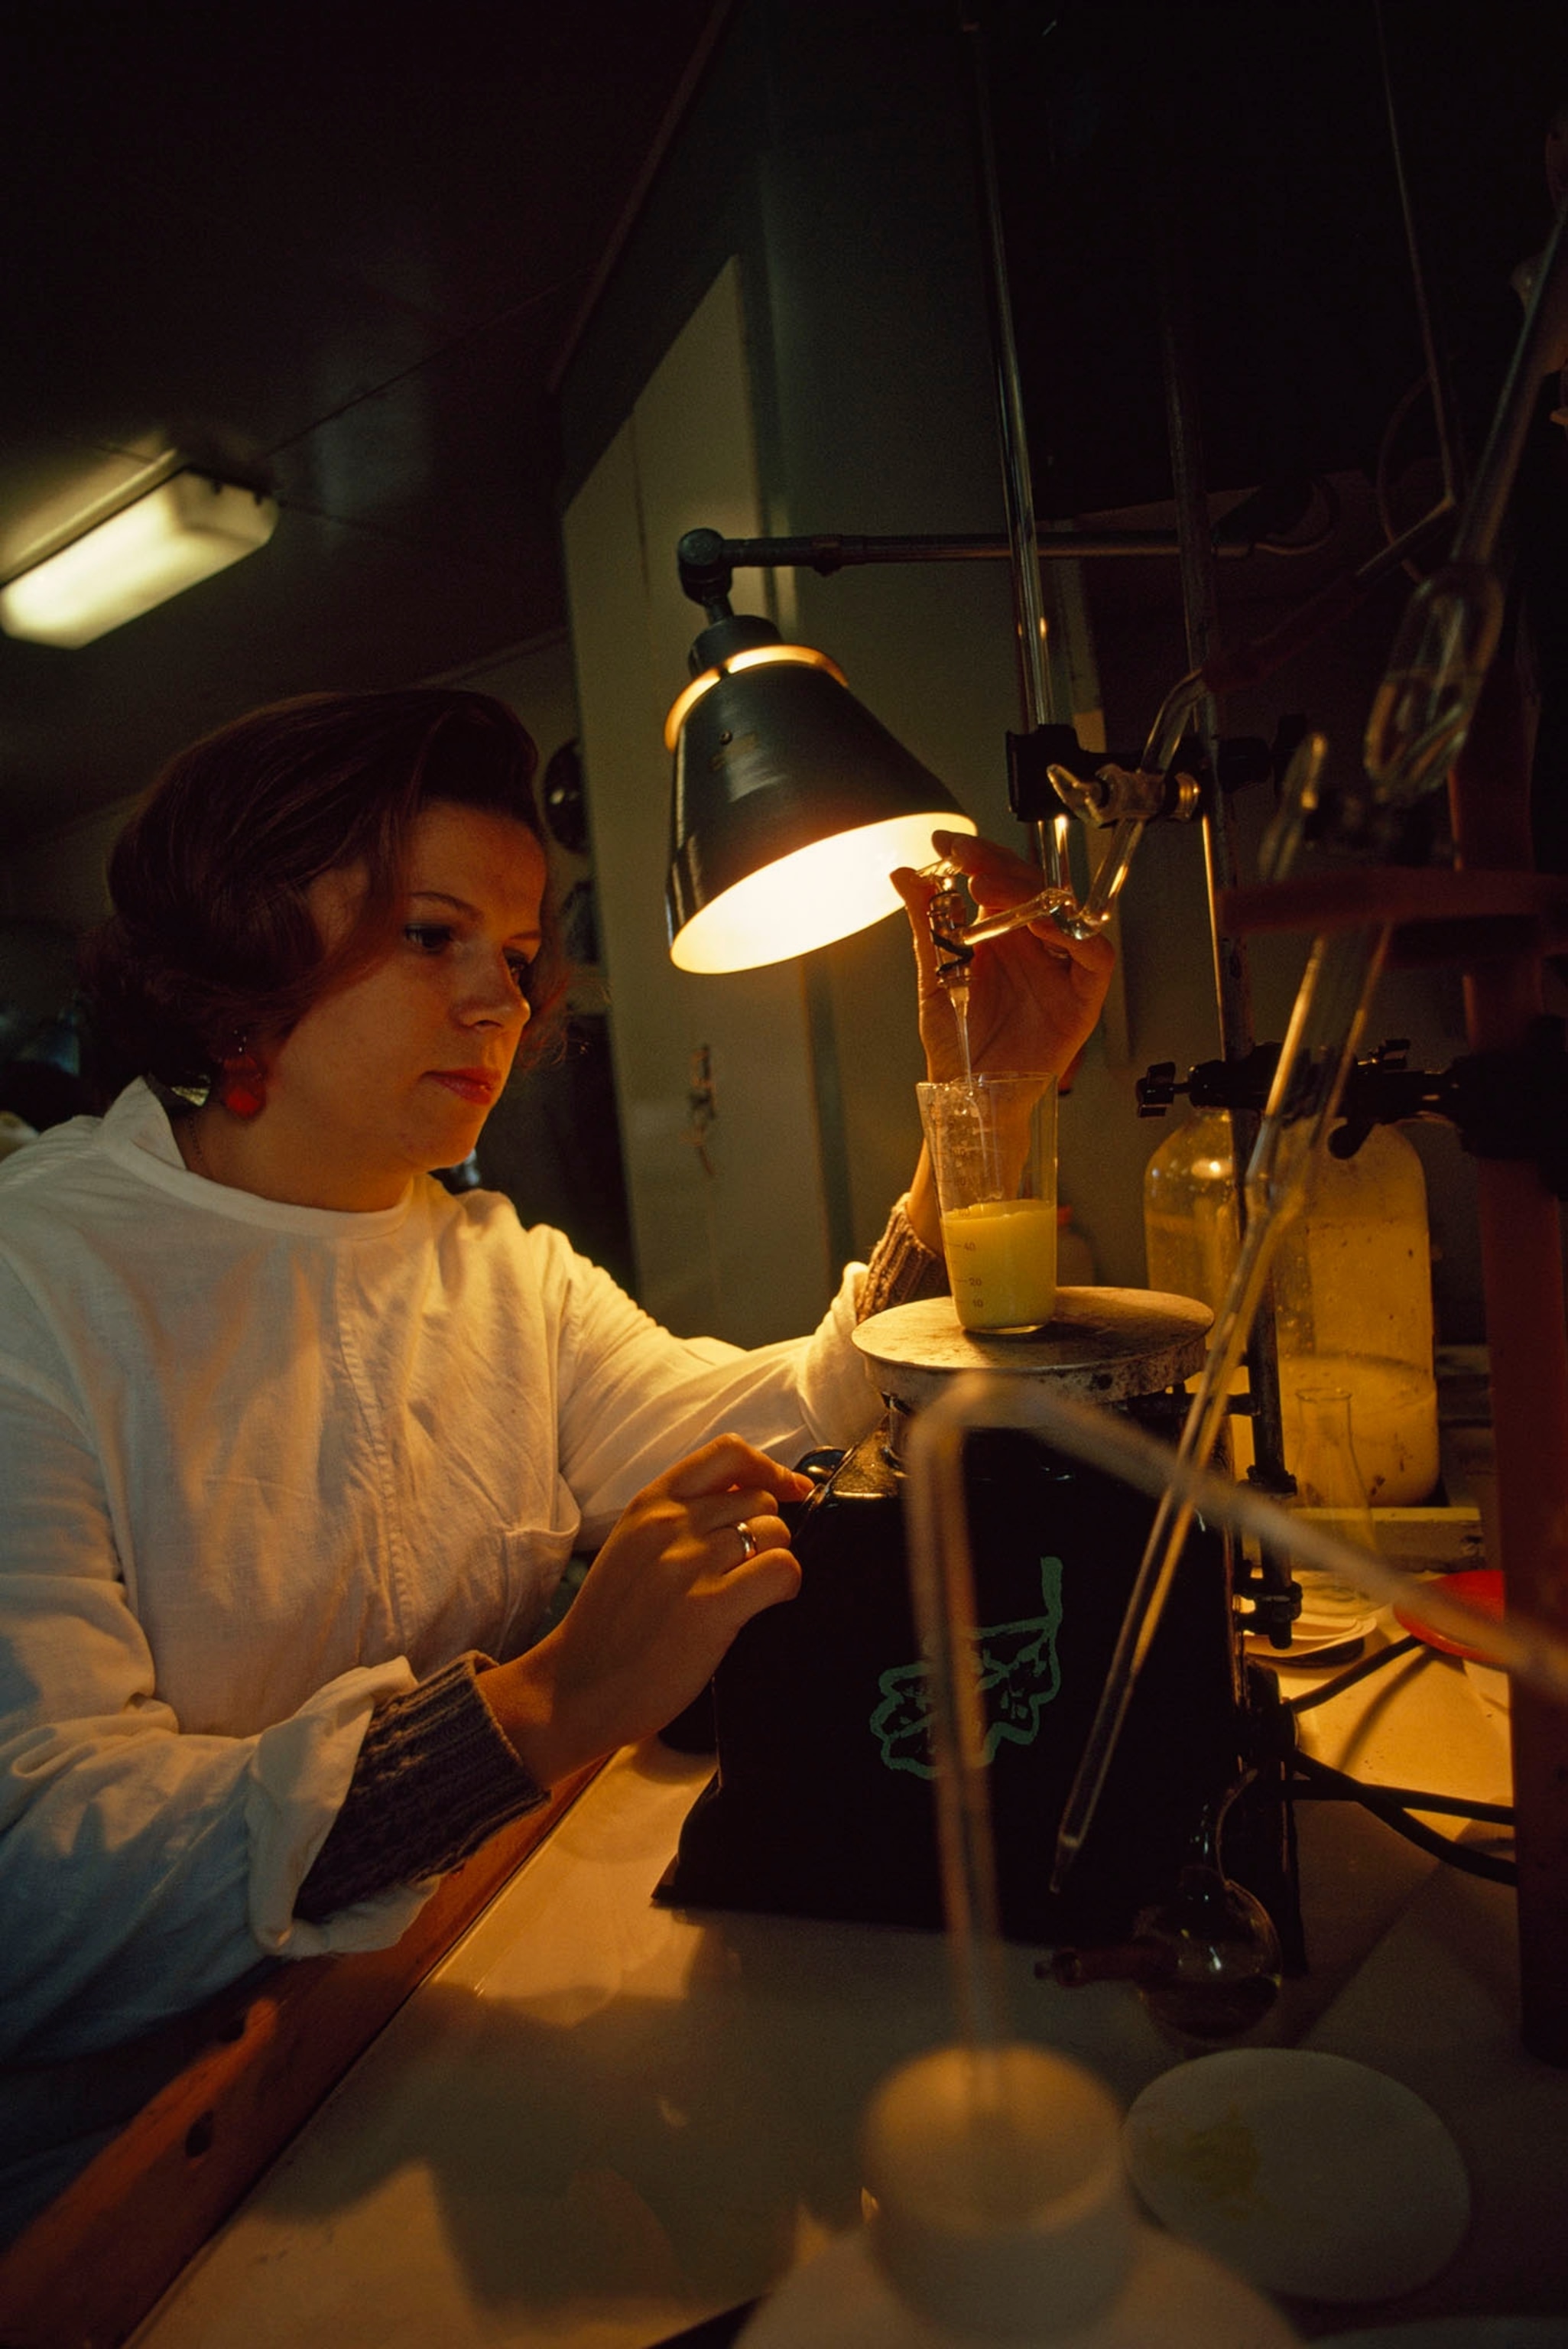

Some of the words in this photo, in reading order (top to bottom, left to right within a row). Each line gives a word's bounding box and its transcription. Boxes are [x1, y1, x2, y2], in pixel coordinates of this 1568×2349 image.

[963, 1243, 976, 1252] 40
[969, 1278, 982, 1286] 20
[972, 1299, 984, 1308] 10
